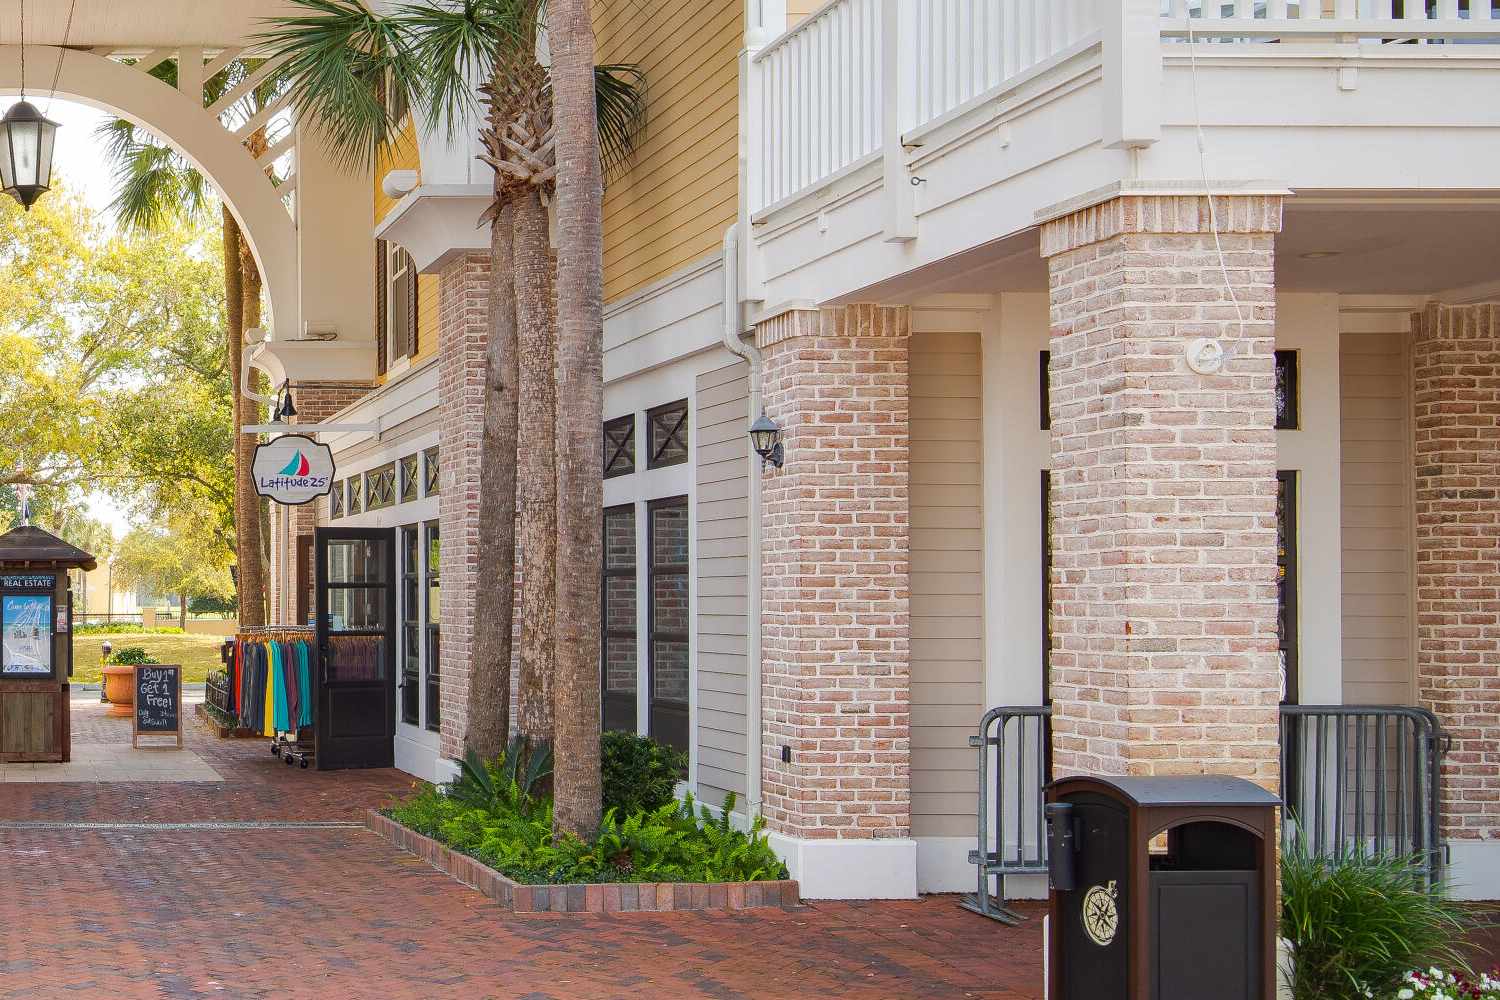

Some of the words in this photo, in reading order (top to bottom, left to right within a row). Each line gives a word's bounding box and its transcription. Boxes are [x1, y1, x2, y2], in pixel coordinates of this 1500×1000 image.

[261, 477, 308, 491] Latitude
[142, 668, 162, 684] Buy
[140, 683, 159, 694] Get
[162, 683, 170, 695] 1
[146, 694, 172, 710] Free!
